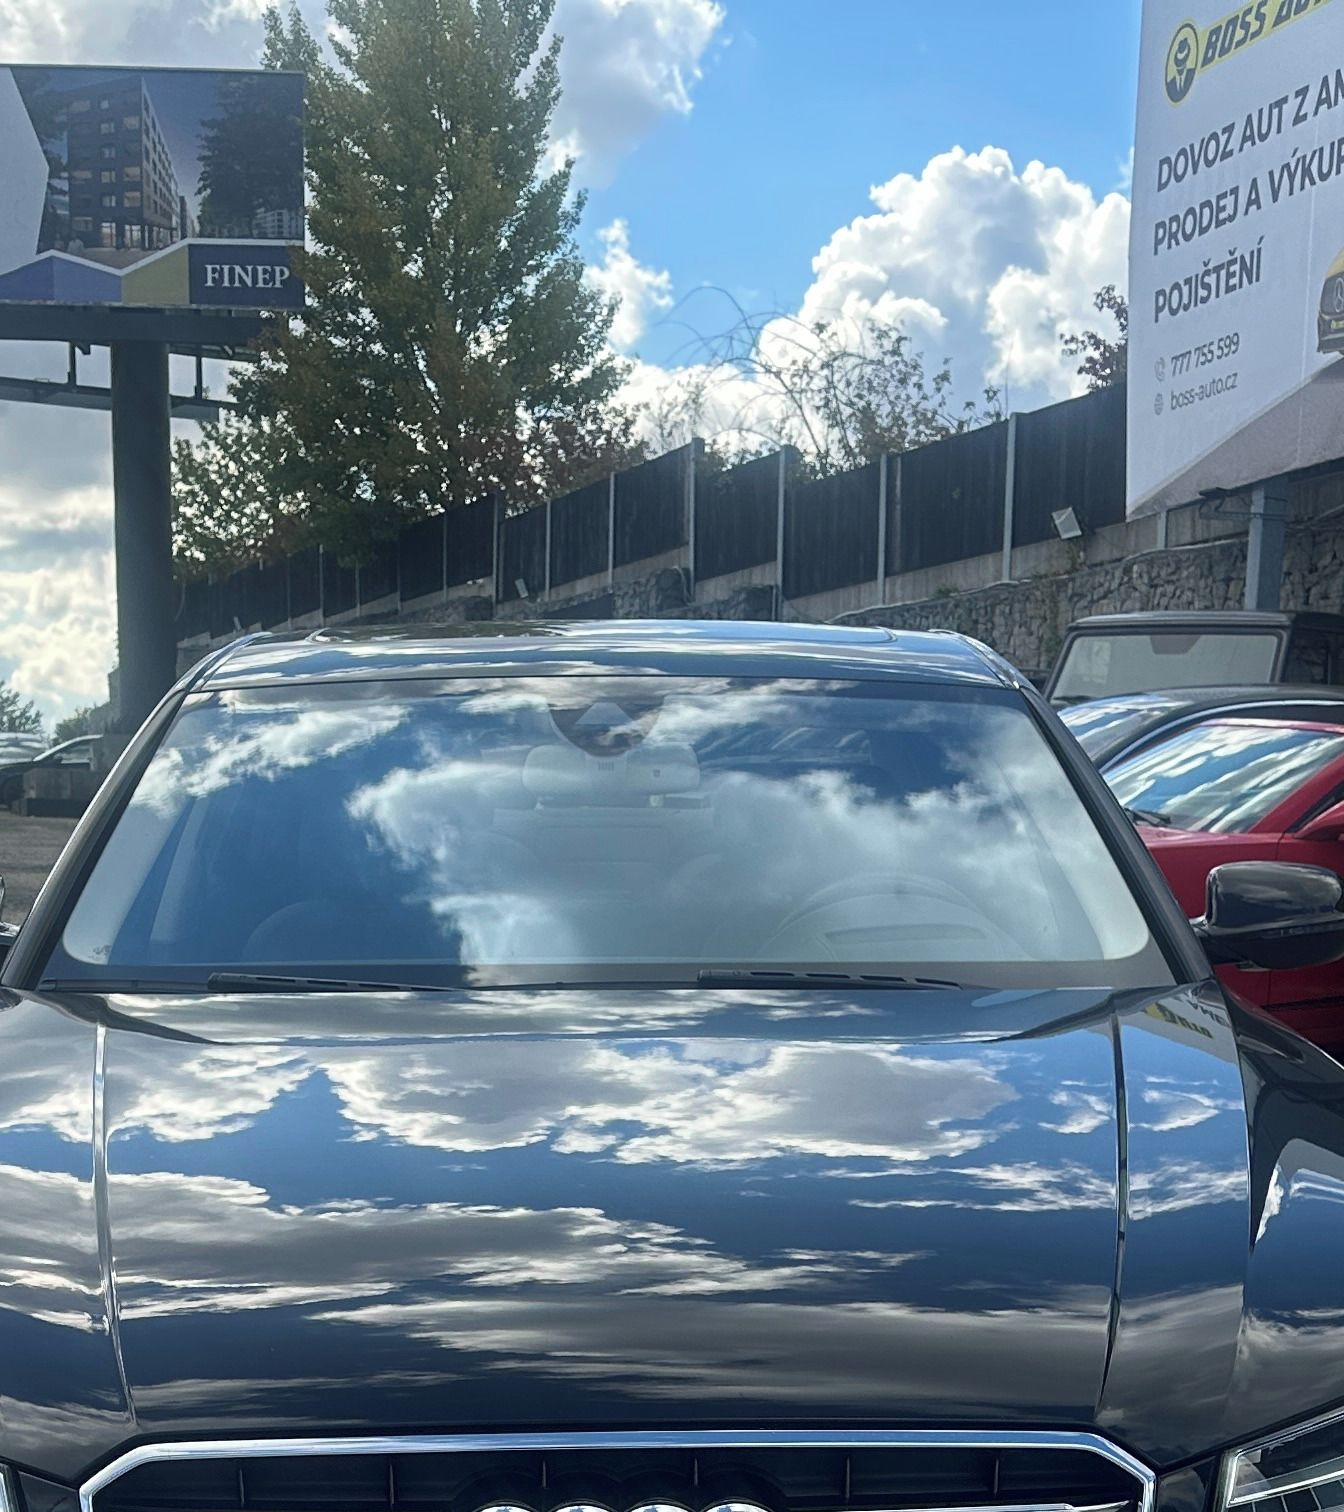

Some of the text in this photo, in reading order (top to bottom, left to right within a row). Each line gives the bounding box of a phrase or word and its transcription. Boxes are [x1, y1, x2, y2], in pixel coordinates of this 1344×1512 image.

[1201, 0, 1268, 68] BOSS
[1157, 122, 1236, 192] DOVOZ
[1238, 96, 1288, 153] AUT
[1292, 84, 1311, 127] Z
[1153, 185, 1240, 256] PRODEJ
[1244, 177, 1262, 217] A
[204, 264, 290, 289] FINEP
[1154, 235, 1264, 323] POJIŠTĚNÍ
[1171, 332, 1240, 377] 777 755 599
[1170, 372, 1238, 411] boss-auto.cz
